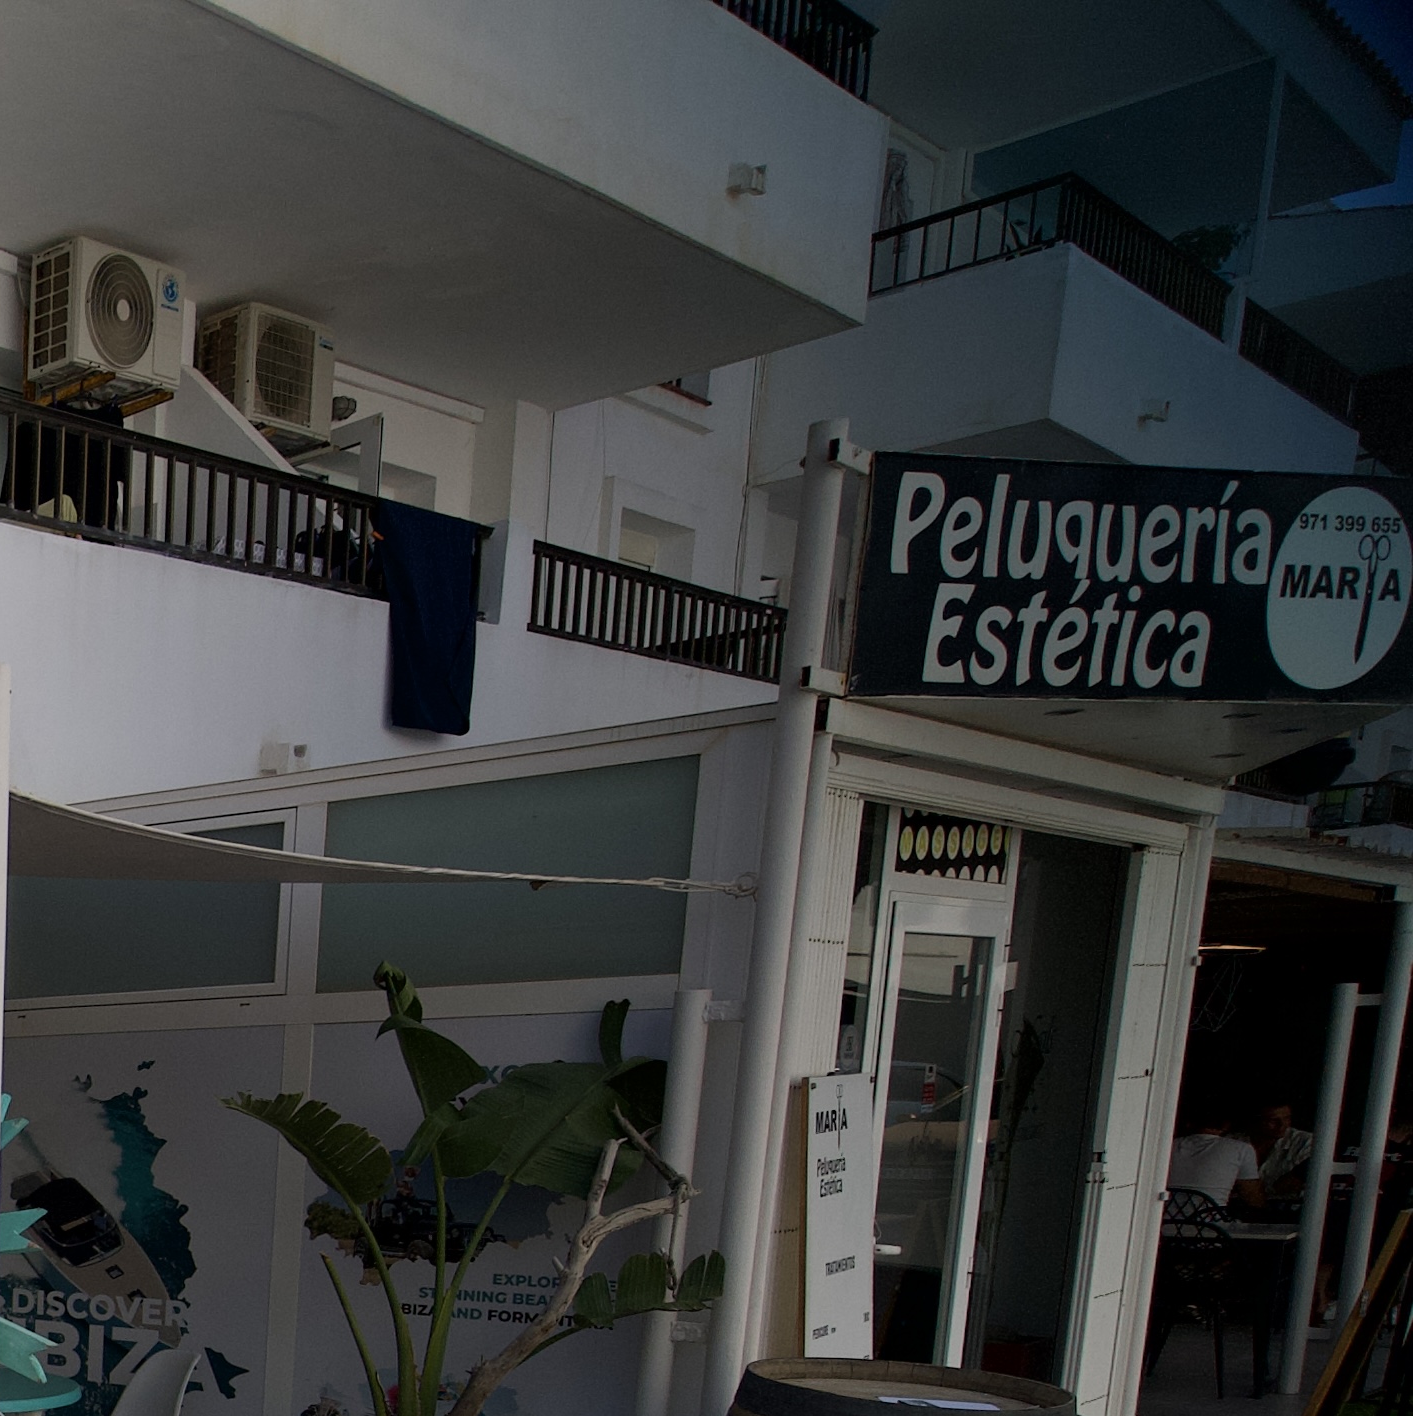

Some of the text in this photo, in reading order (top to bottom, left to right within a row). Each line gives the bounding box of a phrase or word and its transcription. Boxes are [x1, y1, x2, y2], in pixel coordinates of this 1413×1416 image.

[890, 471, 1273, 587] Peluquería
[1298, 512, 1401, 534] 971 399 655
[922, 579, 1211, 690] Estética
[11, 1288, 188, 1327] DISCOVER
